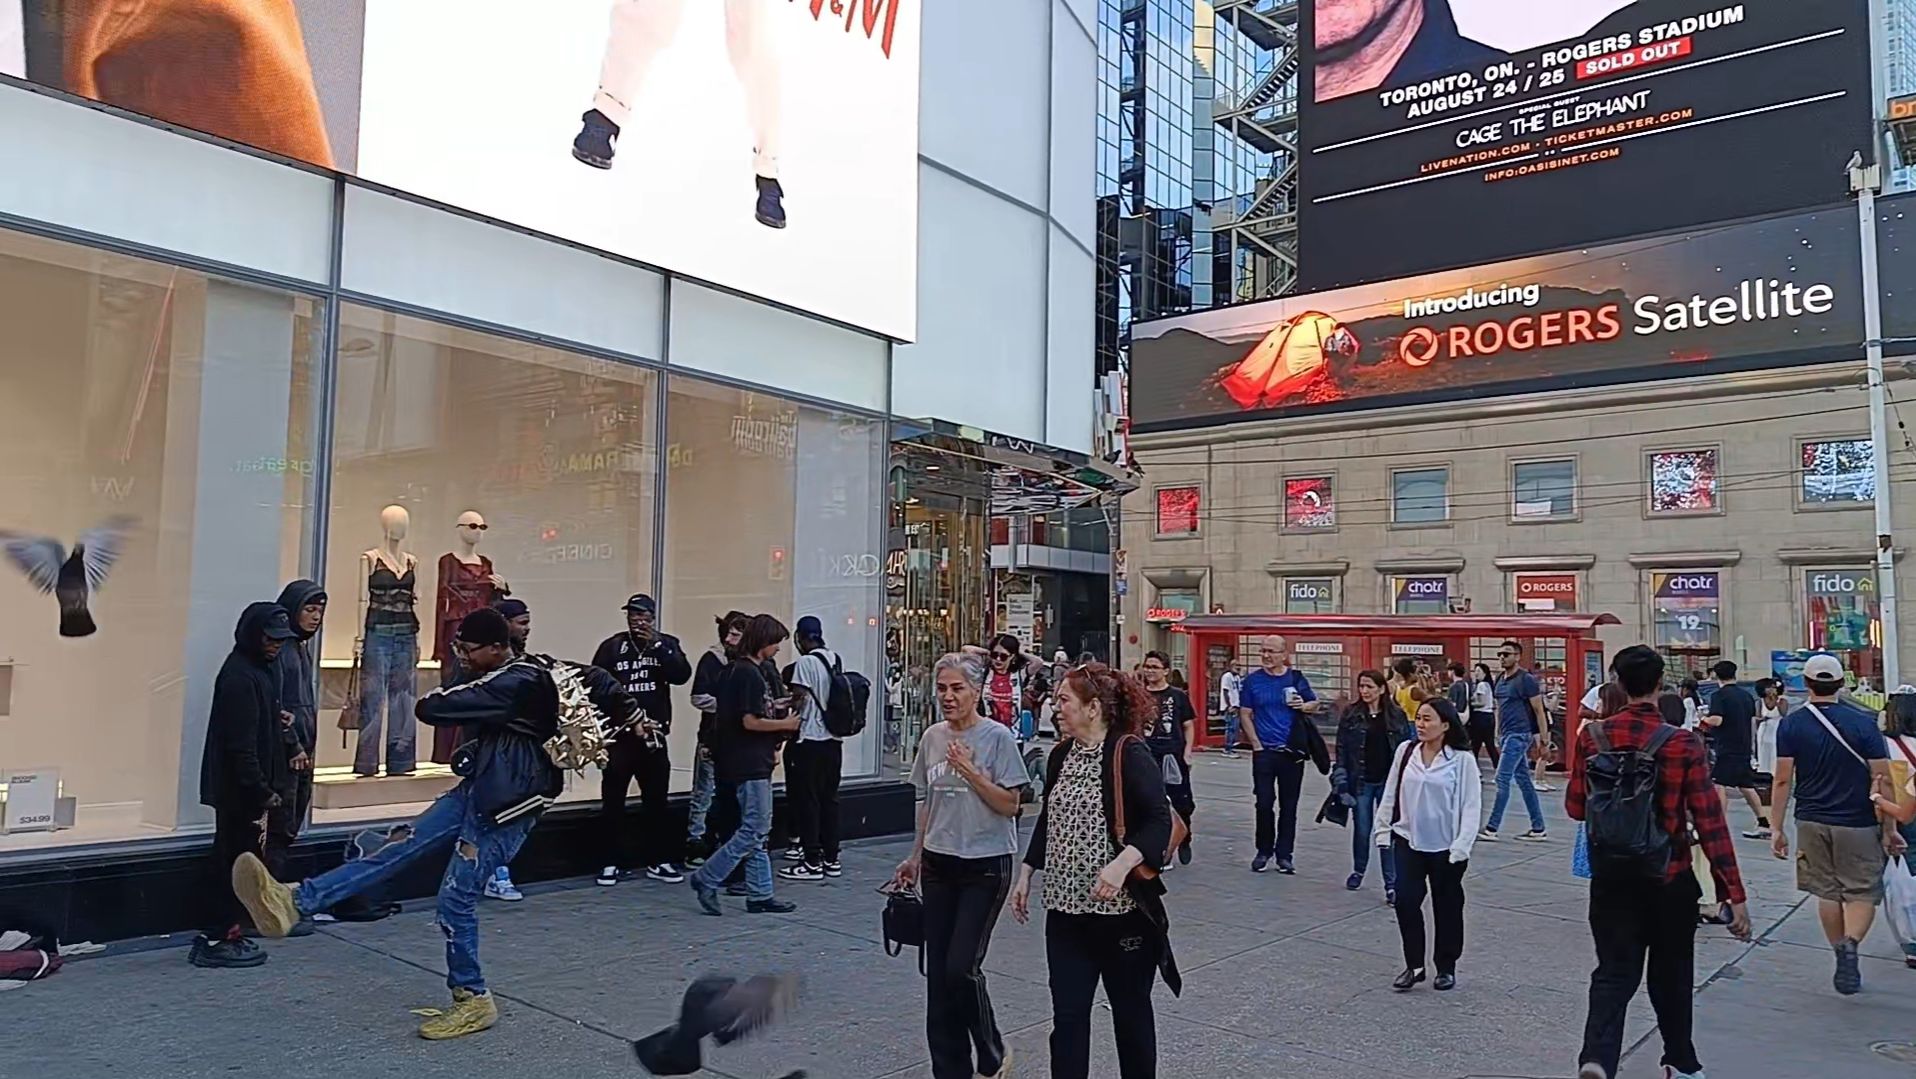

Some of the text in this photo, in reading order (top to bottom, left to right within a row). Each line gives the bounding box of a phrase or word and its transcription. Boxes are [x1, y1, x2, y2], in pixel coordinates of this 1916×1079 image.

[1380, 72, 1478, 107] TORONTO,
[1484, 61, 1519, 81] ON.
[1542, 33, 1632, 68] ROGERS
[1638, 5, 1744, 45] STADIUM
[1586, 41, 1681, 75] SOLD OUT
[1407, 68, 1565, 118] AUGUST 24 / 25
[1518, 96, 1581, 115] SPECIAL GUEST
[1456, 89, 1651, 148] CAGE THE ELEPHANT
[1420, 108, 1693, 173] LIVENATION.COM TICKETMASTER.COM
[1404, 283, 1540, 319] Introducing
[1449, 278, 1834, 358] ROGERS Satellite
[1408, 581, 1443, 593] chatr
[1533, 582, 1573, 592] ROGERS
[1670, 575, 1712, 589] chatr
[1813, 574, 1854, 592] fido
[1290, 584, 1317, 599] fido
[1156, 608, 1185, 618] ROGERS
[1298, 644, 1340, 652] TELEPHONE
[1394, 645, 1440, 653] TELEPHONE
[614, 661, 630, 671] OS
[623, 681, 657, 693] AKERS
